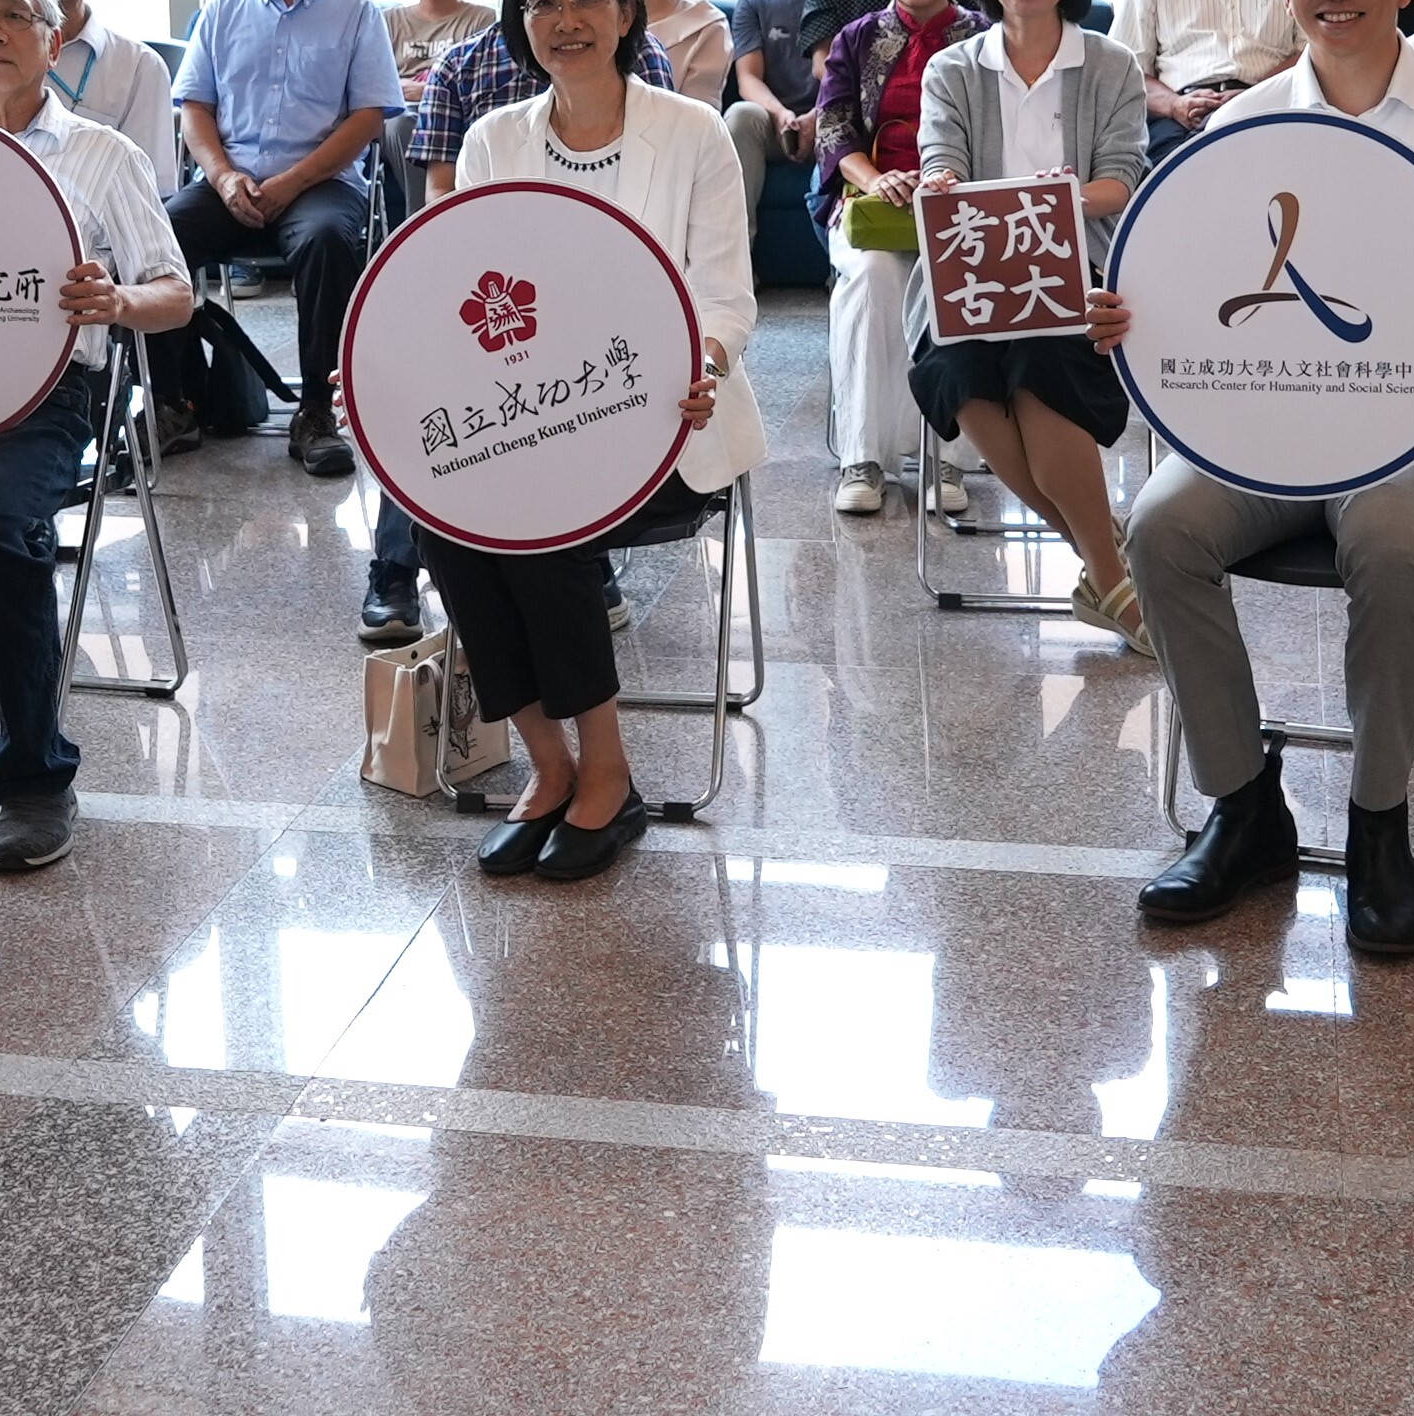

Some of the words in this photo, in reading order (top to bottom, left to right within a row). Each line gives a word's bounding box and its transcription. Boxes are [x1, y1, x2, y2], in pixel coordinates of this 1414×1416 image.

[7, 314, 40, 324] University
[504, 350, 530, 366] 1931
[1160, 379, 1208, 391] Research
[1211, 379, 1247, 391] Center
[1250, 380, 1266, 391] for
[1269, 381, 1322, 395] Humanity
[1325, 382, 1345, 393] and
[1348, 382, 1383, 394] Social
[420, 335, 642, 456] 國立成功大學
[430, 447, 491, 479] National
[492, 432, 538, 456] Cheng
[537, 417, 577, 441] Kung
[576, 392, 649, 426] University
